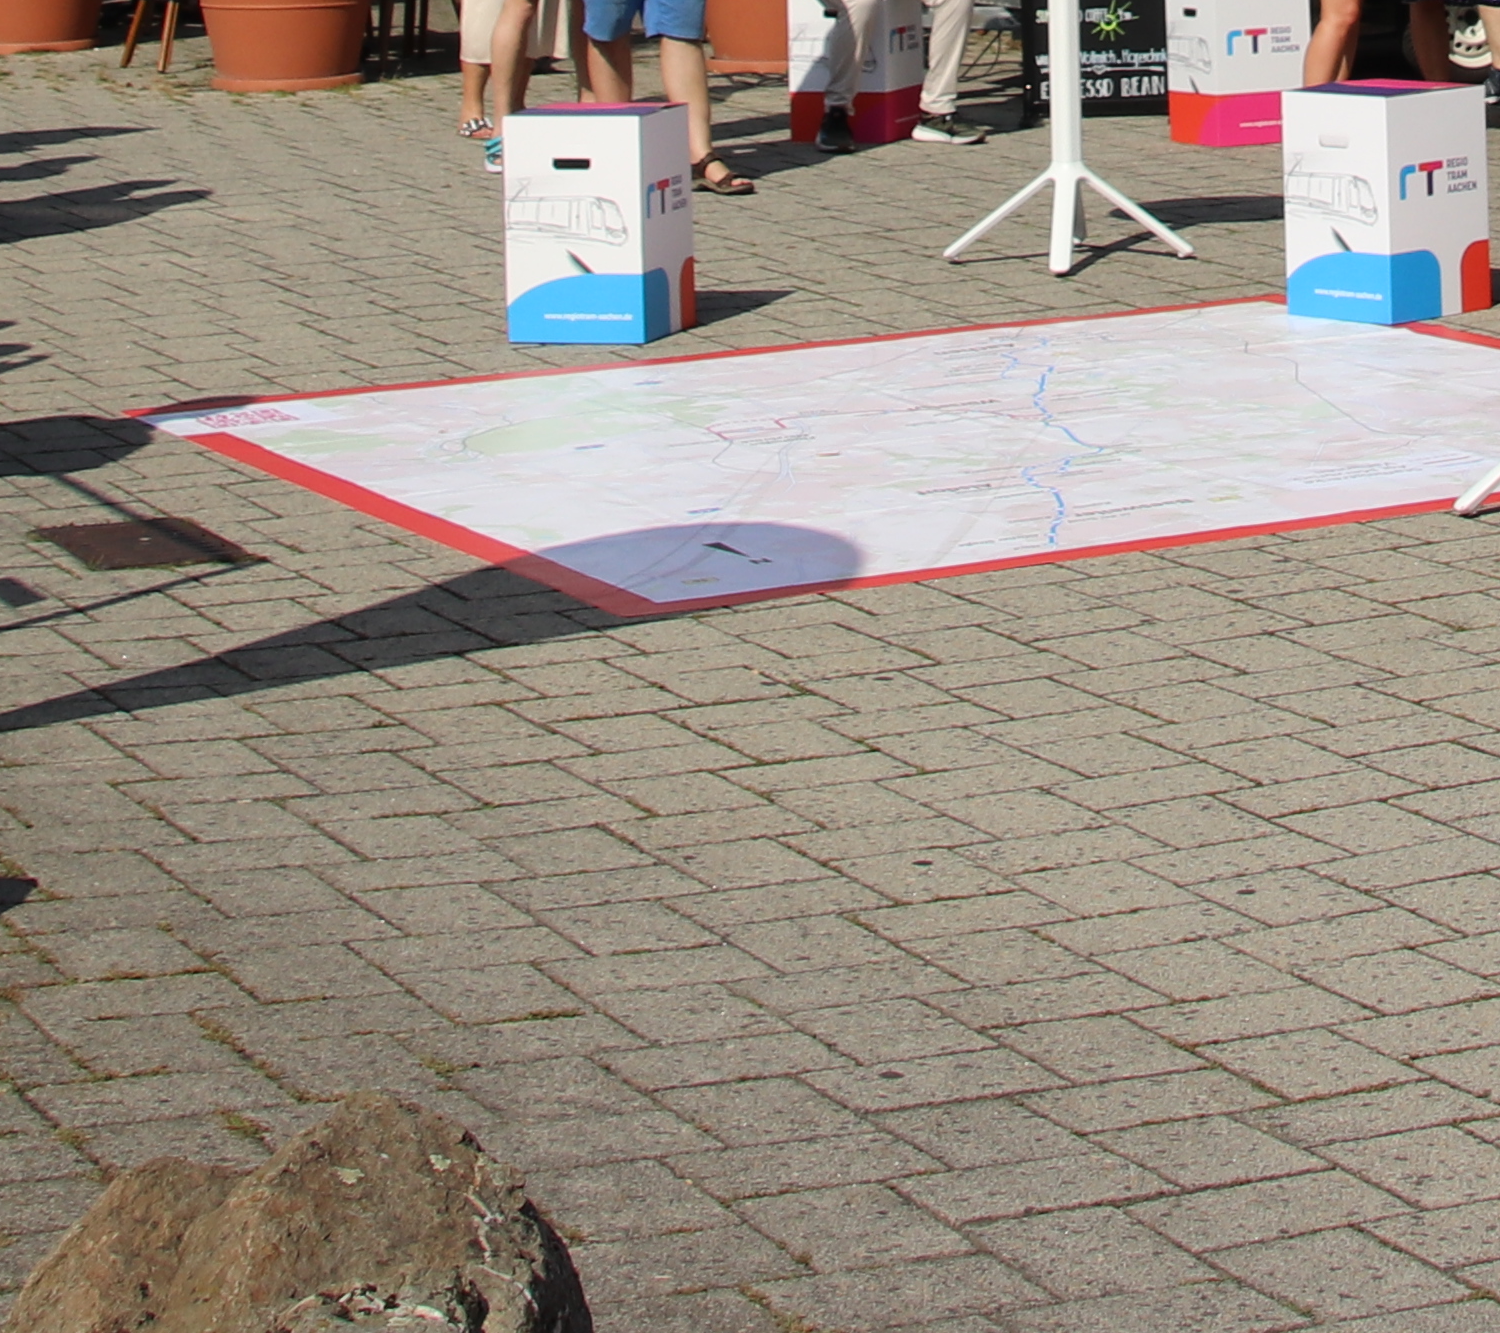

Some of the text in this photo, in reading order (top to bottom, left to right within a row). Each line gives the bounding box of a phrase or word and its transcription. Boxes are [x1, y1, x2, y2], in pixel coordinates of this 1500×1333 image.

[1121, 75, 1166, 98] BEAN
[1446, 156, 1468, 168] REGIO
[1447, 169, 1468, 181] TRAM
[1447, 180, 1477, 194] AACHEN
